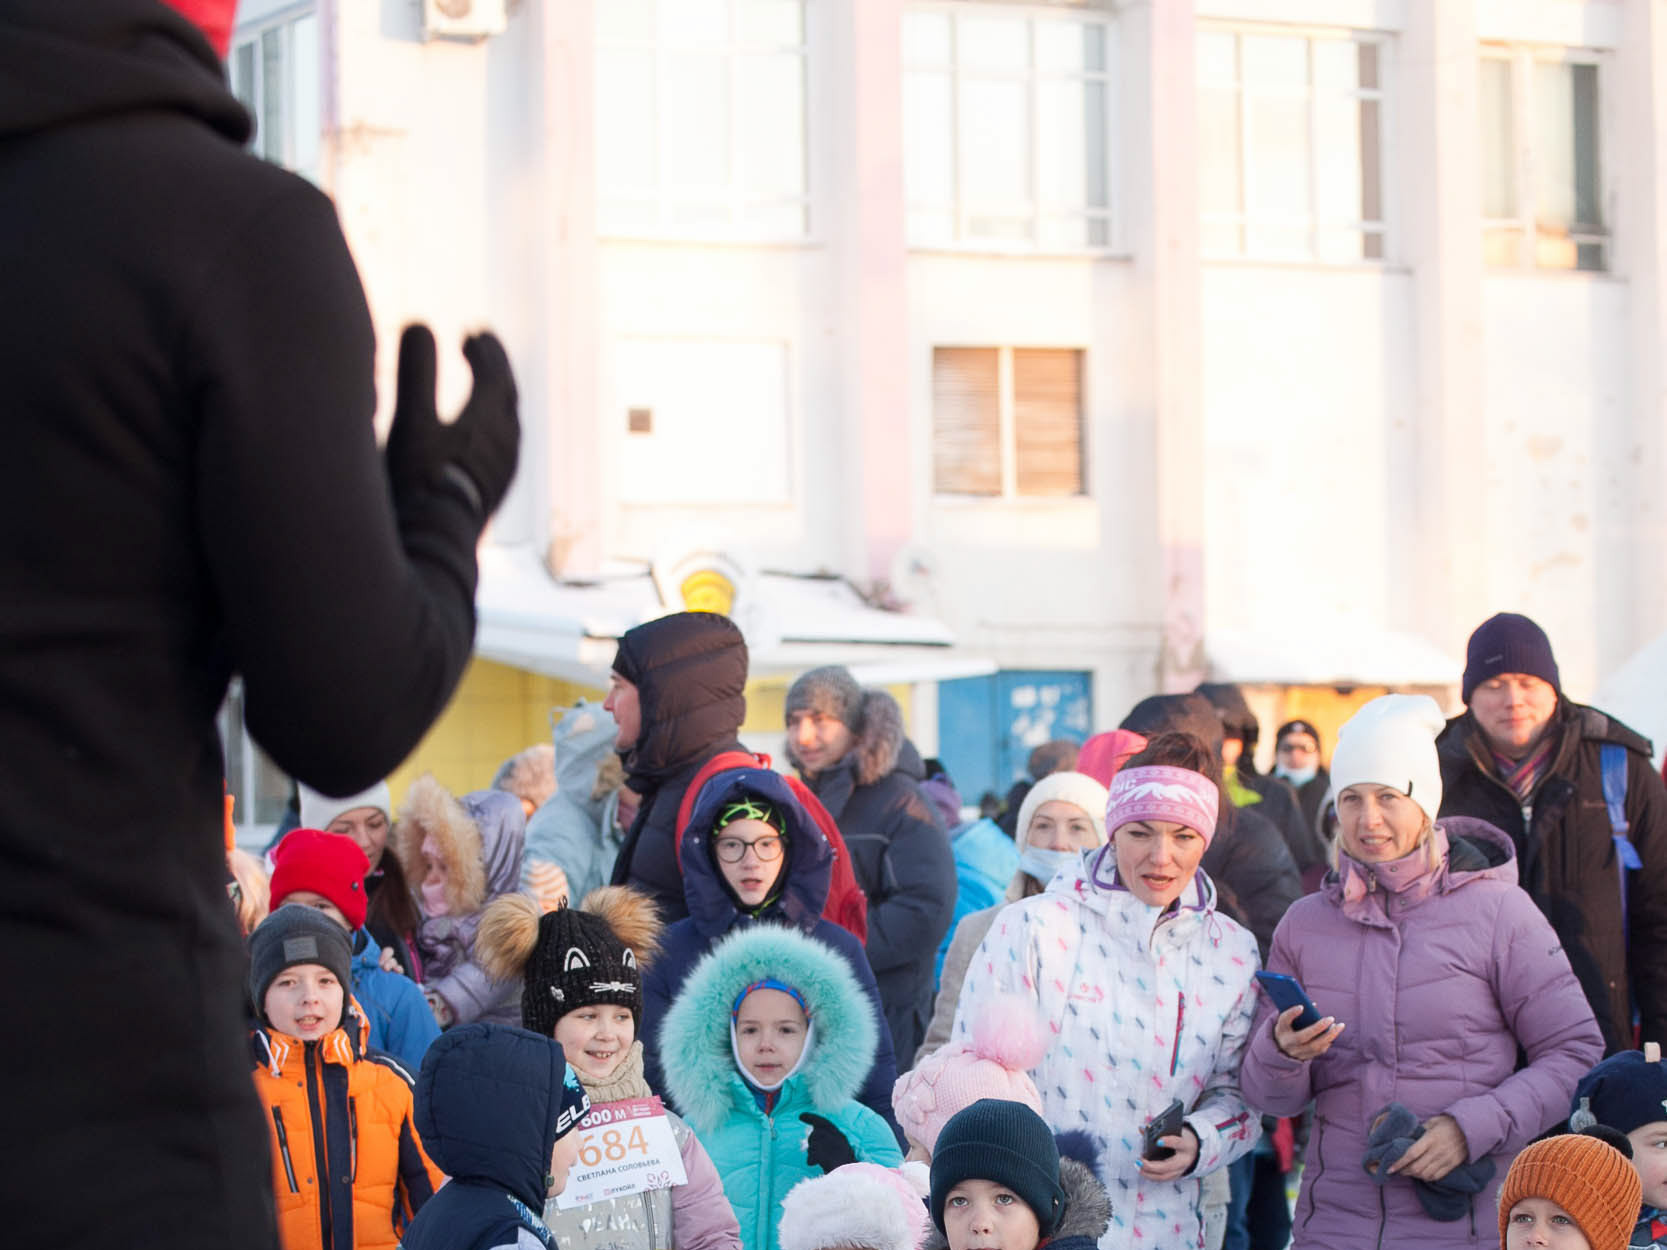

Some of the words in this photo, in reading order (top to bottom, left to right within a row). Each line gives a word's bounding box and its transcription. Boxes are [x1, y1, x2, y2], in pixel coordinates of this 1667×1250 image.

[581, 1108, 613, 1128] 600
[579, 1125, 649, 1167] 684
[577, 1167, 617, 1182] СВЕТЛАНА
